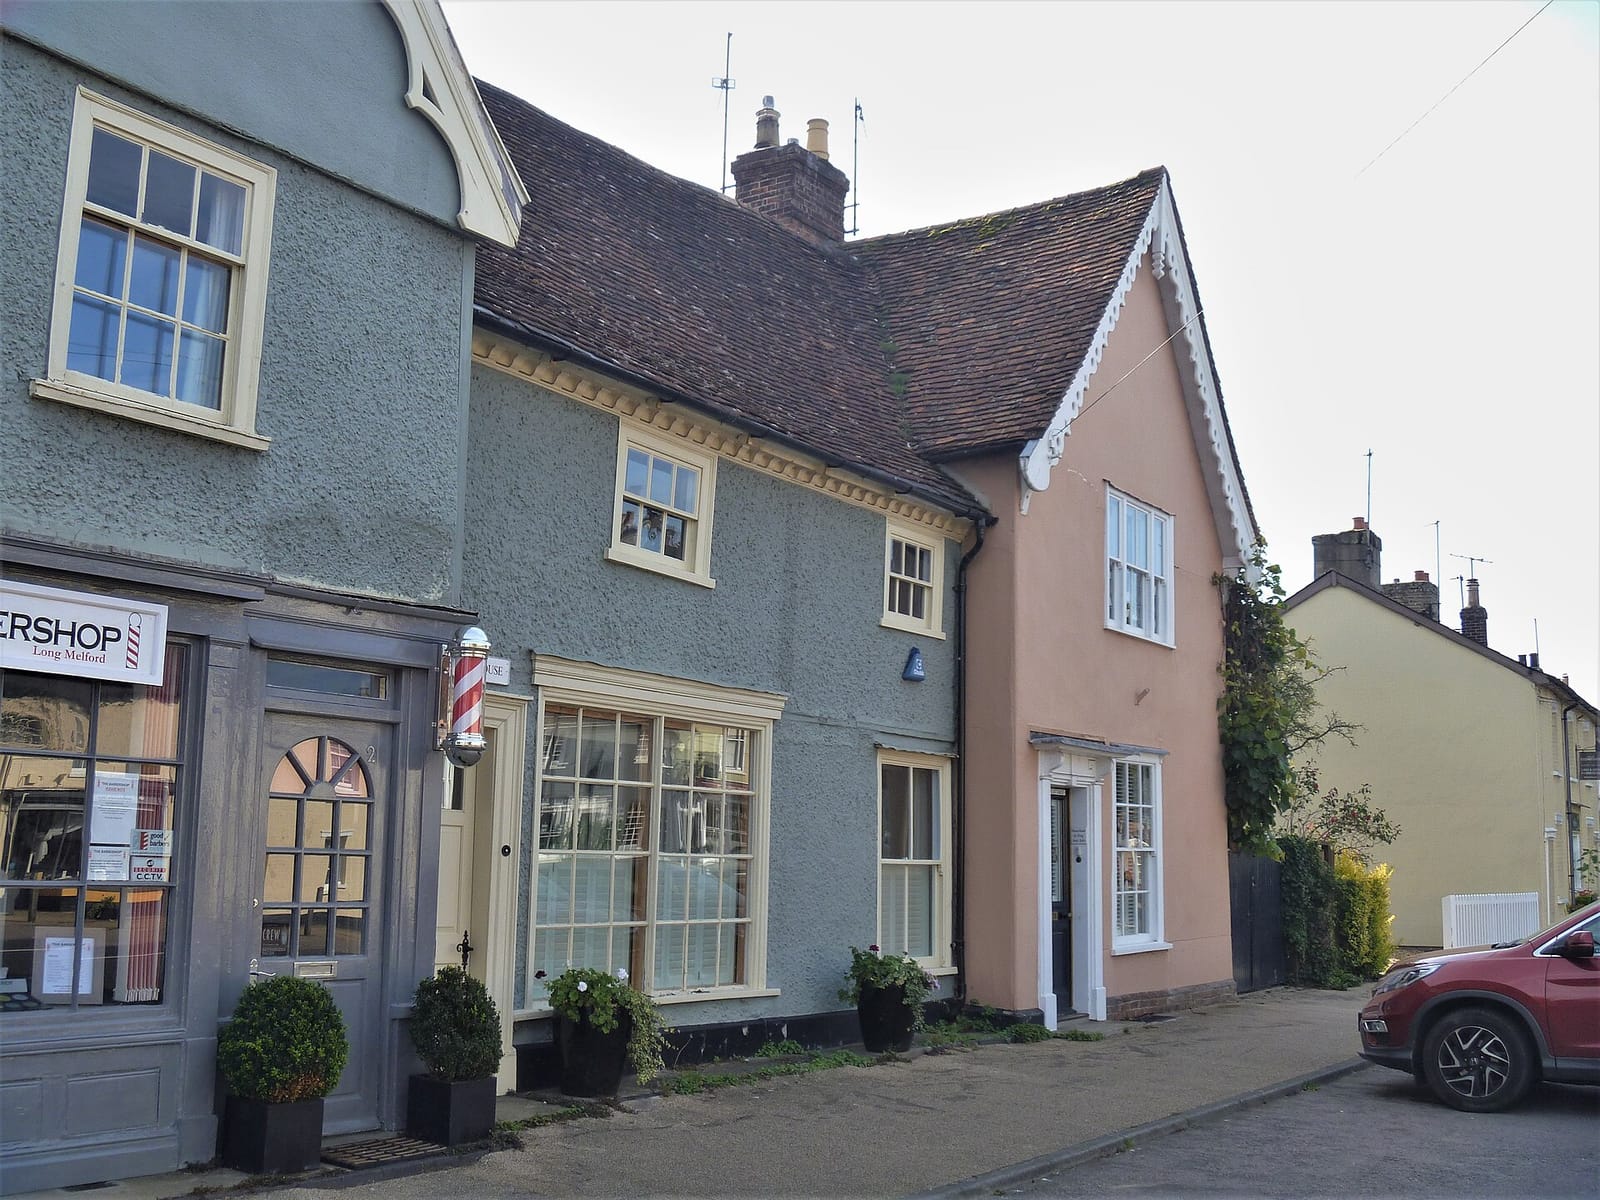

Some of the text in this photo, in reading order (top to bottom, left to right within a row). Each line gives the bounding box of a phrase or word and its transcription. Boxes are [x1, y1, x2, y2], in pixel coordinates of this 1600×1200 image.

[33, 645, 106, 664] Long Melford
[486, 664, 503, 676] USE
[366, 745, 376, 763] 2
